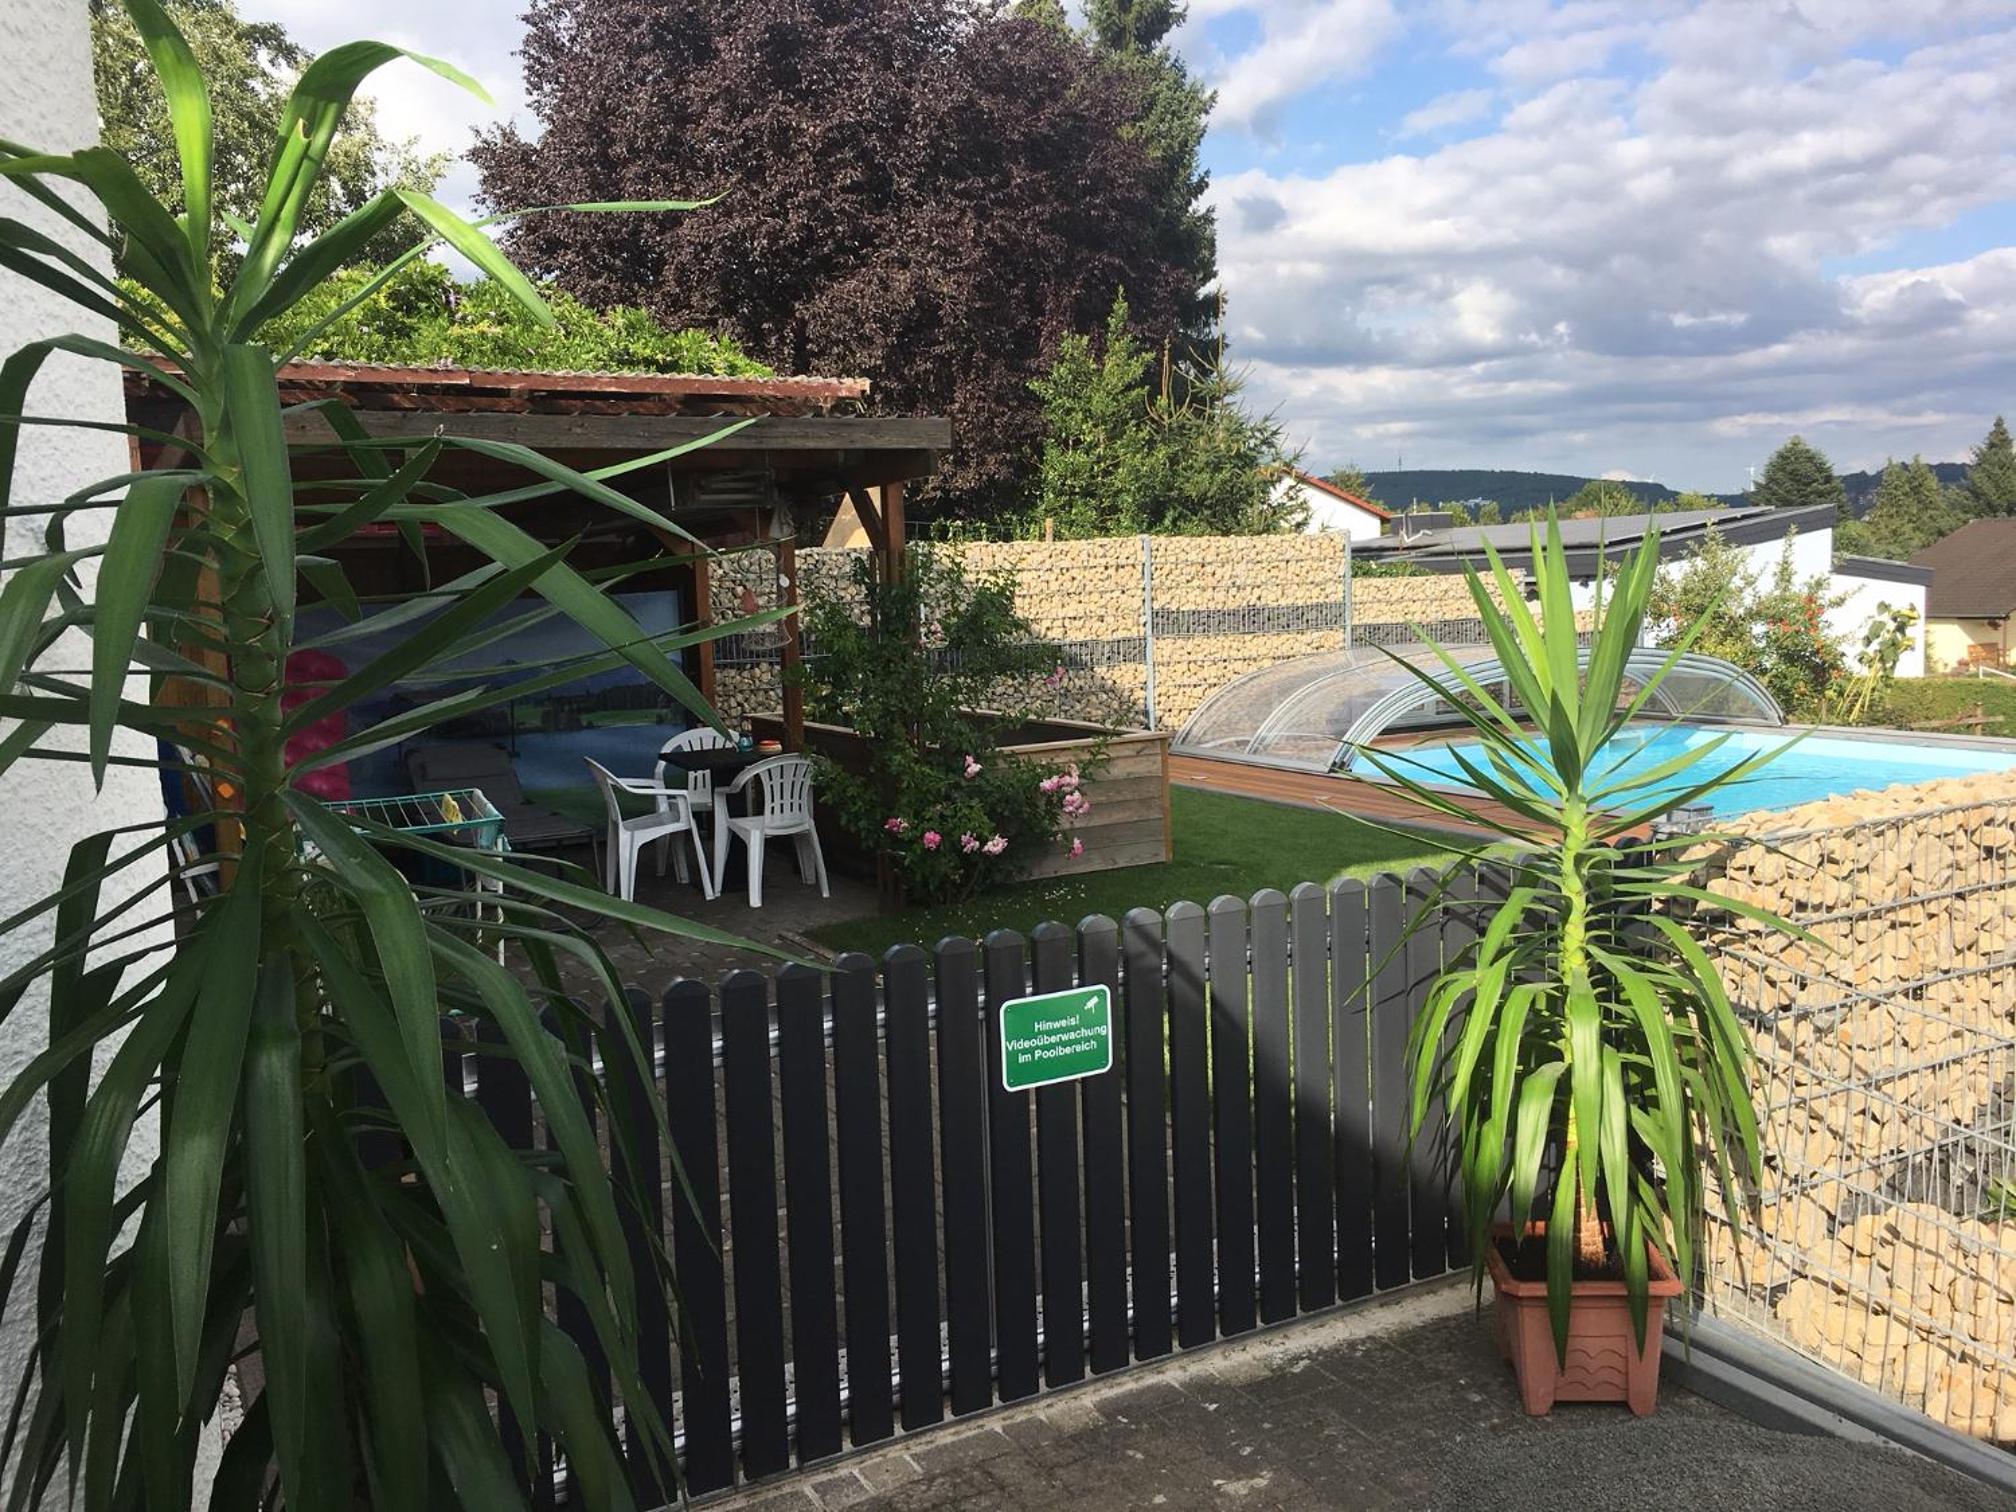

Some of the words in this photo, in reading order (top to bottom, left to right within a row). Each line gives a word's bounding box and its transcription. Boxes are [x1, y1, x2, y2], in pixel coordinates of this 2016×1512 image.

[1034, 1014, 1080, 1032] Hinweis!
[1006, 1025, 1107, 1051] Videoüberwachung
[1034, 1040, 1097, 1060] Poolbereich
